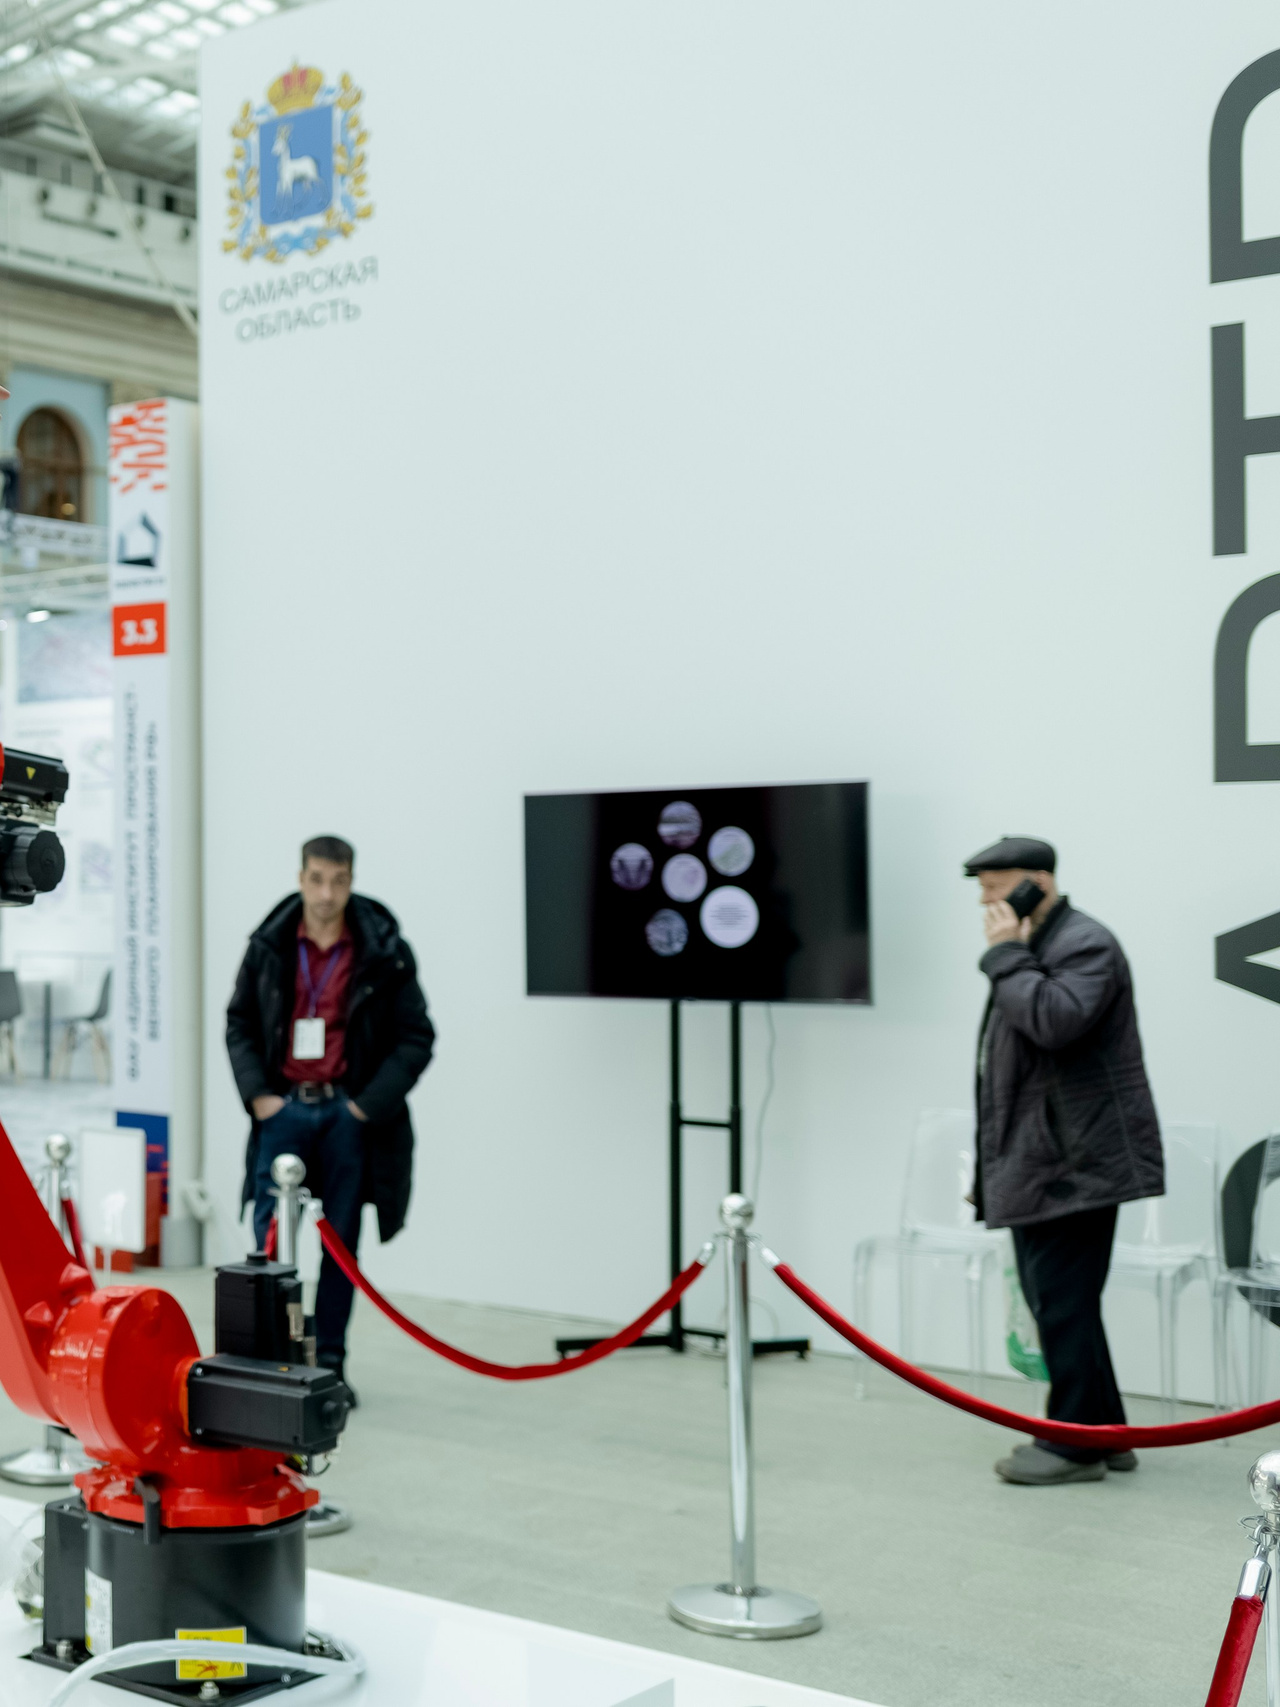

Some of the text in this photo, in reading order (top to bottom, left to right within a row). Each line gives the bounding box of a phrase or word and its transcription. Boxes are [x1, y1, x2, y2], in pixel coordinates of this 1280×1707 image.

[218, 254, 380, 316] САМАРСКАЯ
[234, 297, 362, 343] ОБЛАСТЬ
[121, 617, 158, 647] 3.3
